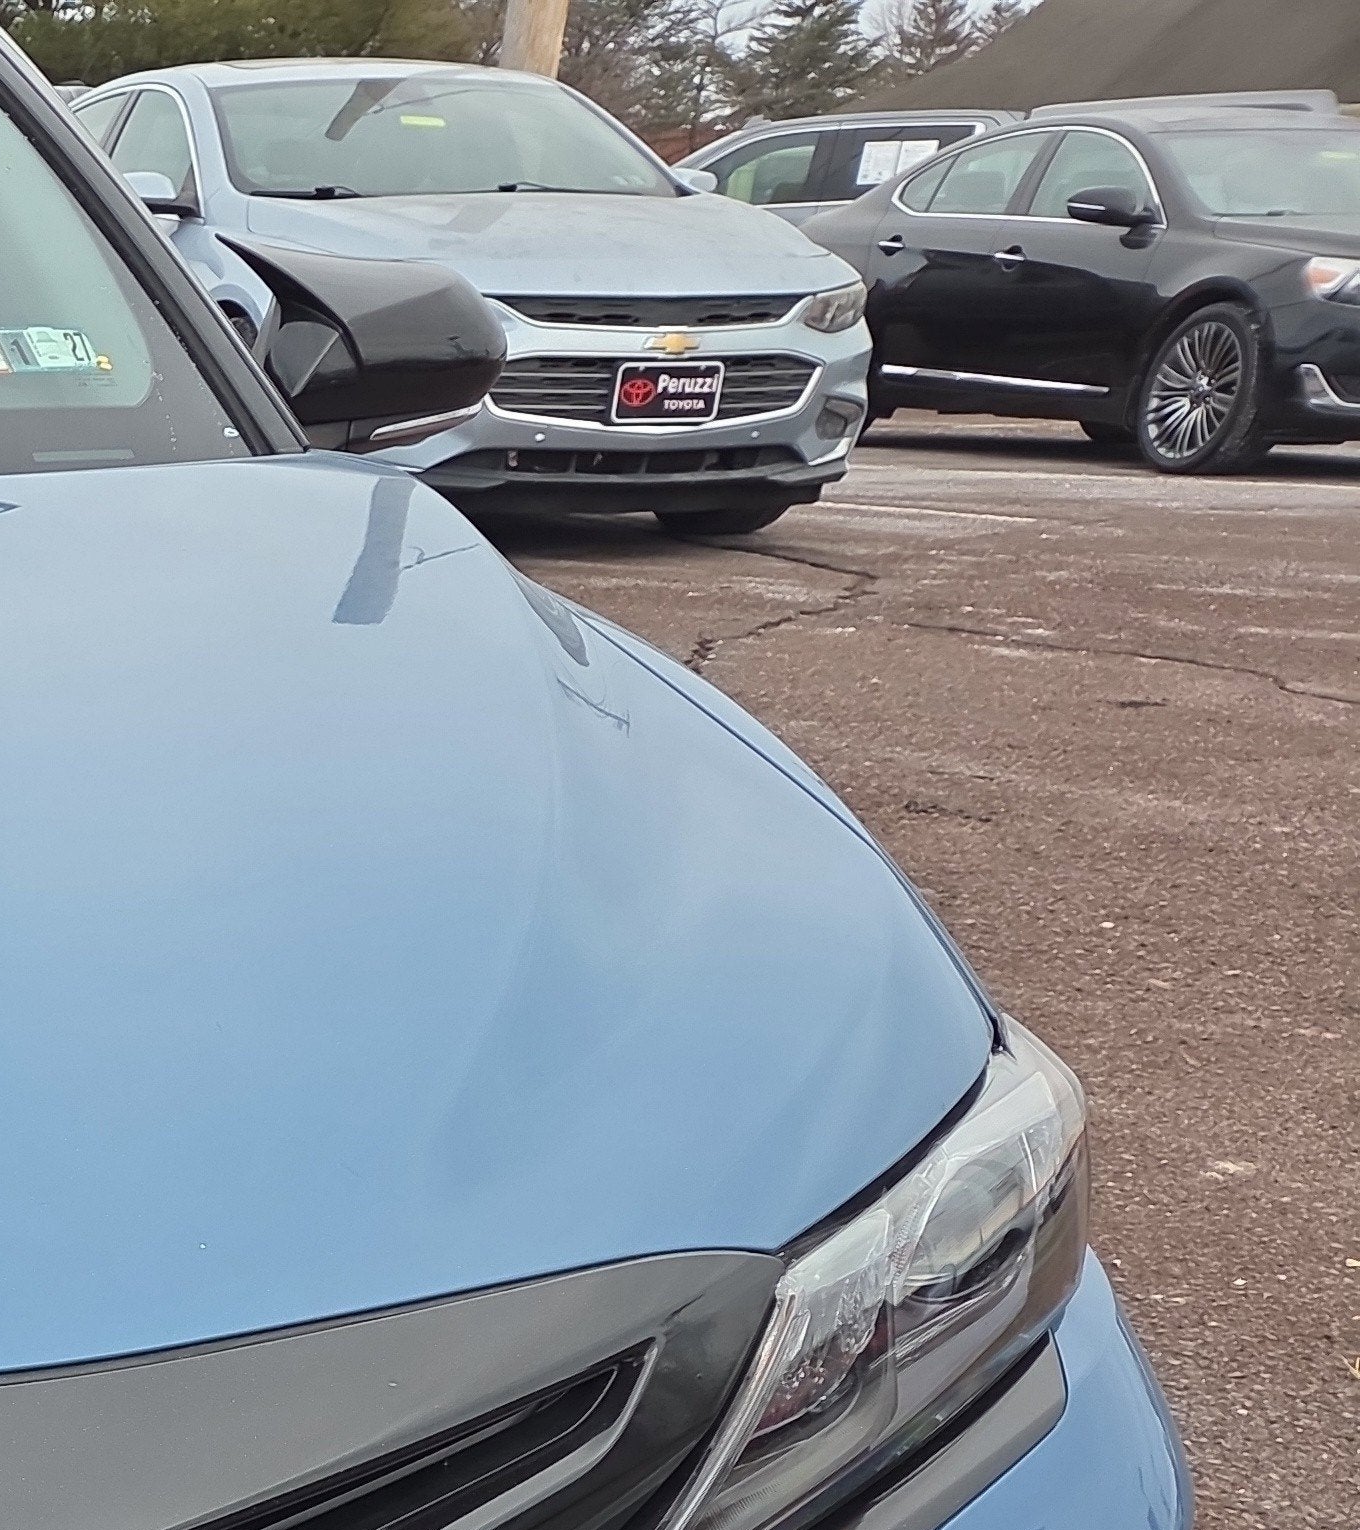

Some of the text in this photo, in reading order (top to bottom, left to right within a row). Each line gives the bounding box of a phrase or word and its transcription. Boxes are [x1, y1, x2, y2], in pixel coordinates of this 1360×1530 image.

[62, 331, 92, 362] 27
[656, 373, 720, 394] Peruzzi
[663, 398, 706, 411] TOYOTA
